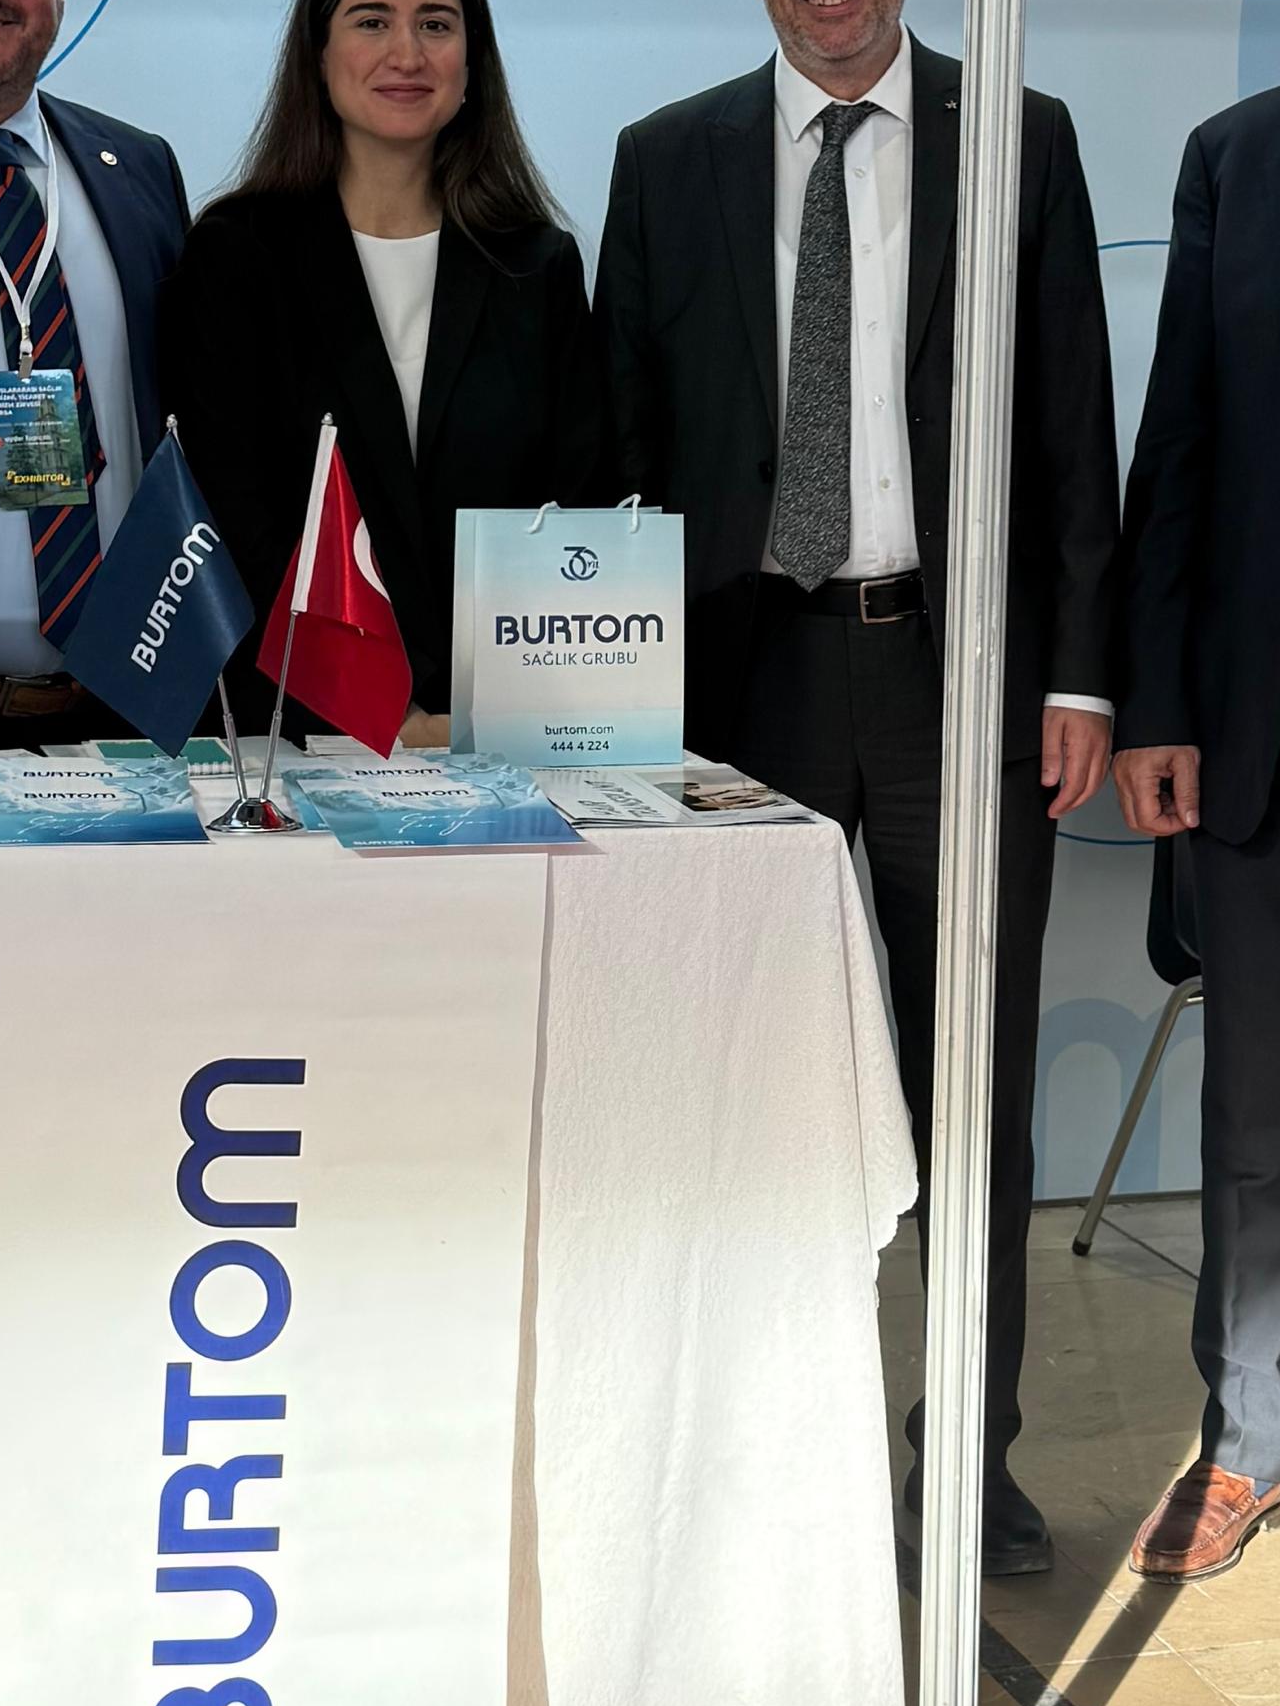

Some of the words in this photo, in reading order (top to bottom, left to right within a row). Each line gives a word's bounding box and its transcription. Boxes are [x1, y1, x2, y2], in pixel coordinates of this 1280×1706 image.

[14, 473, 64, 484] EXHIBITOR
[131, 521, 220, 673] BURTOM
[495, 613, 663, 645] BURTOM
[521, 650, 577, 666] SAĞLIK
[582, 651, 639, 665] GRUBU
[544, 724, 614, 737] burtom.com
[550, 741, 575, 752] 444
[577, 741, 585, 752] 4
[587, 740, 610, 751] 224
[22, 769, 114, 778] BURTOM
[354, 767, 442, 776] BURTOM
[23, 792, 117, 800] BURTOM
[380, 789, 470, 797] BURTOM
